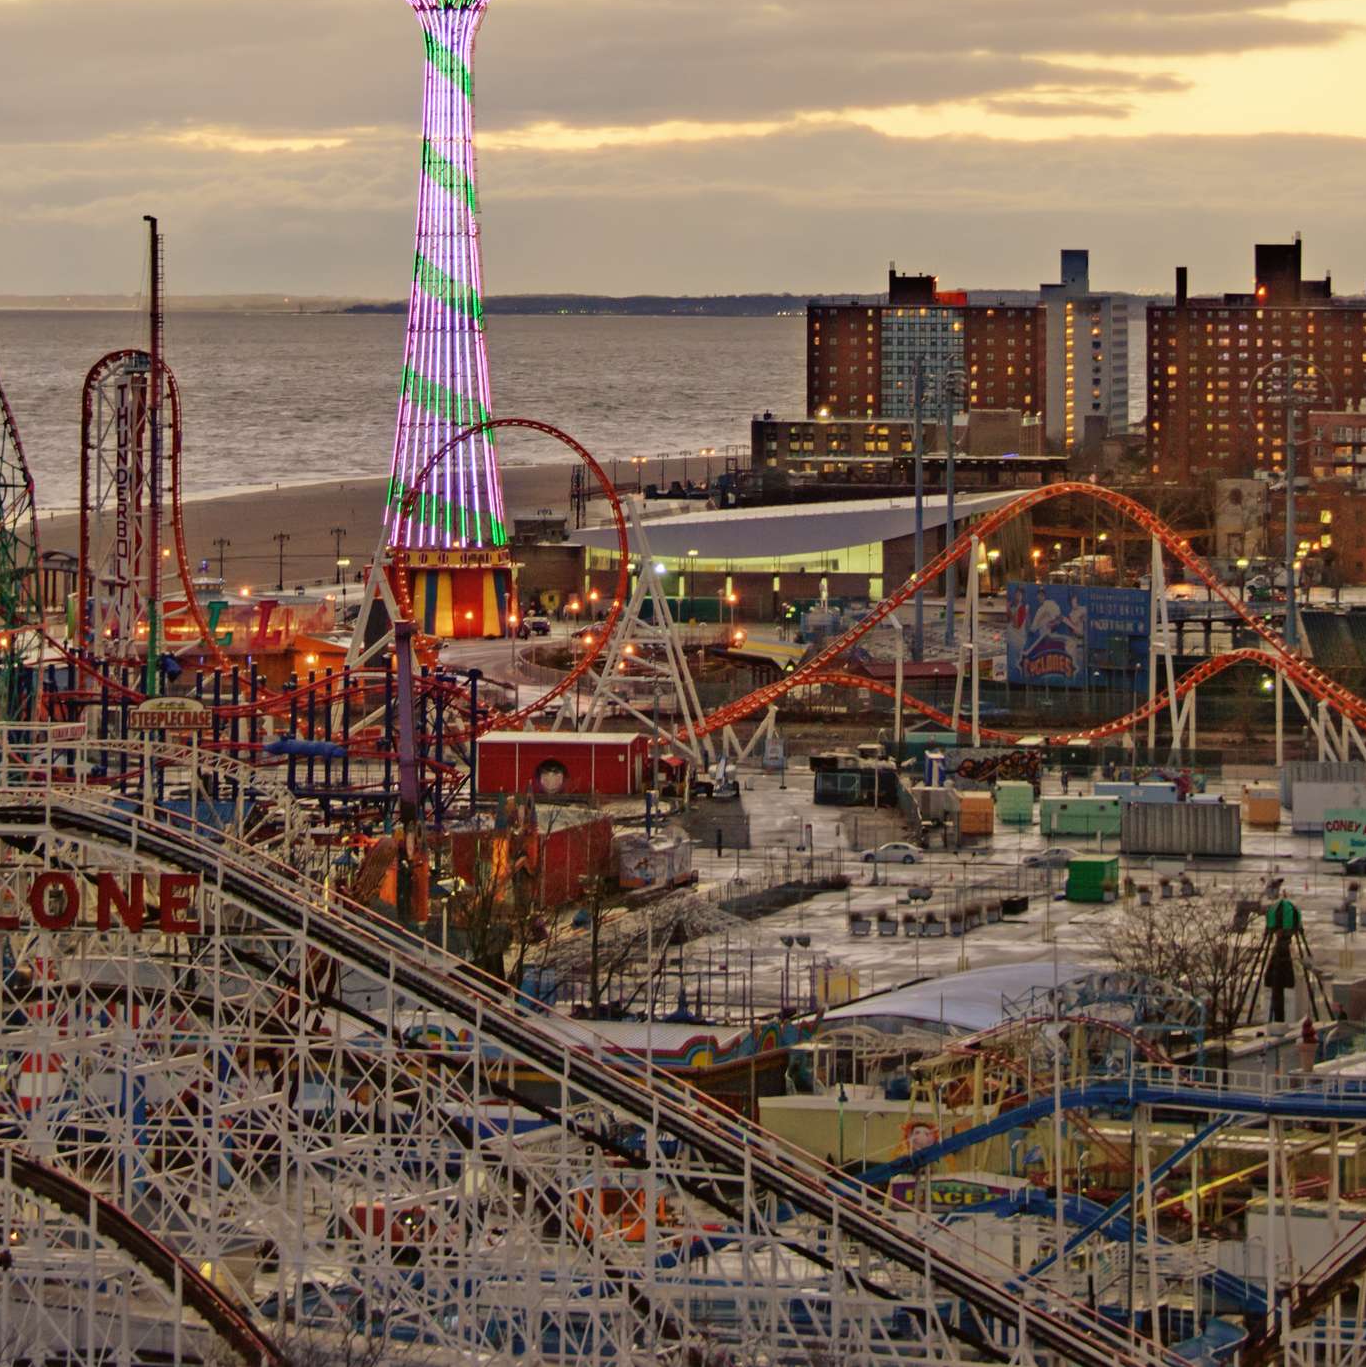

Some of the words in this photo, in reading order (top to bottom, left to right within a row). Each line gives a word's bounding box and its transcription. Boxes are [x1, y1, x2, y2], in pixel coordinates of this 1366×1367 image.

[116, 383, 129, 607] THUNDERBOLT
[130, 711, 212, 727] STEEPLECHASE
[1325, 819, 1361, 833] CONEY
